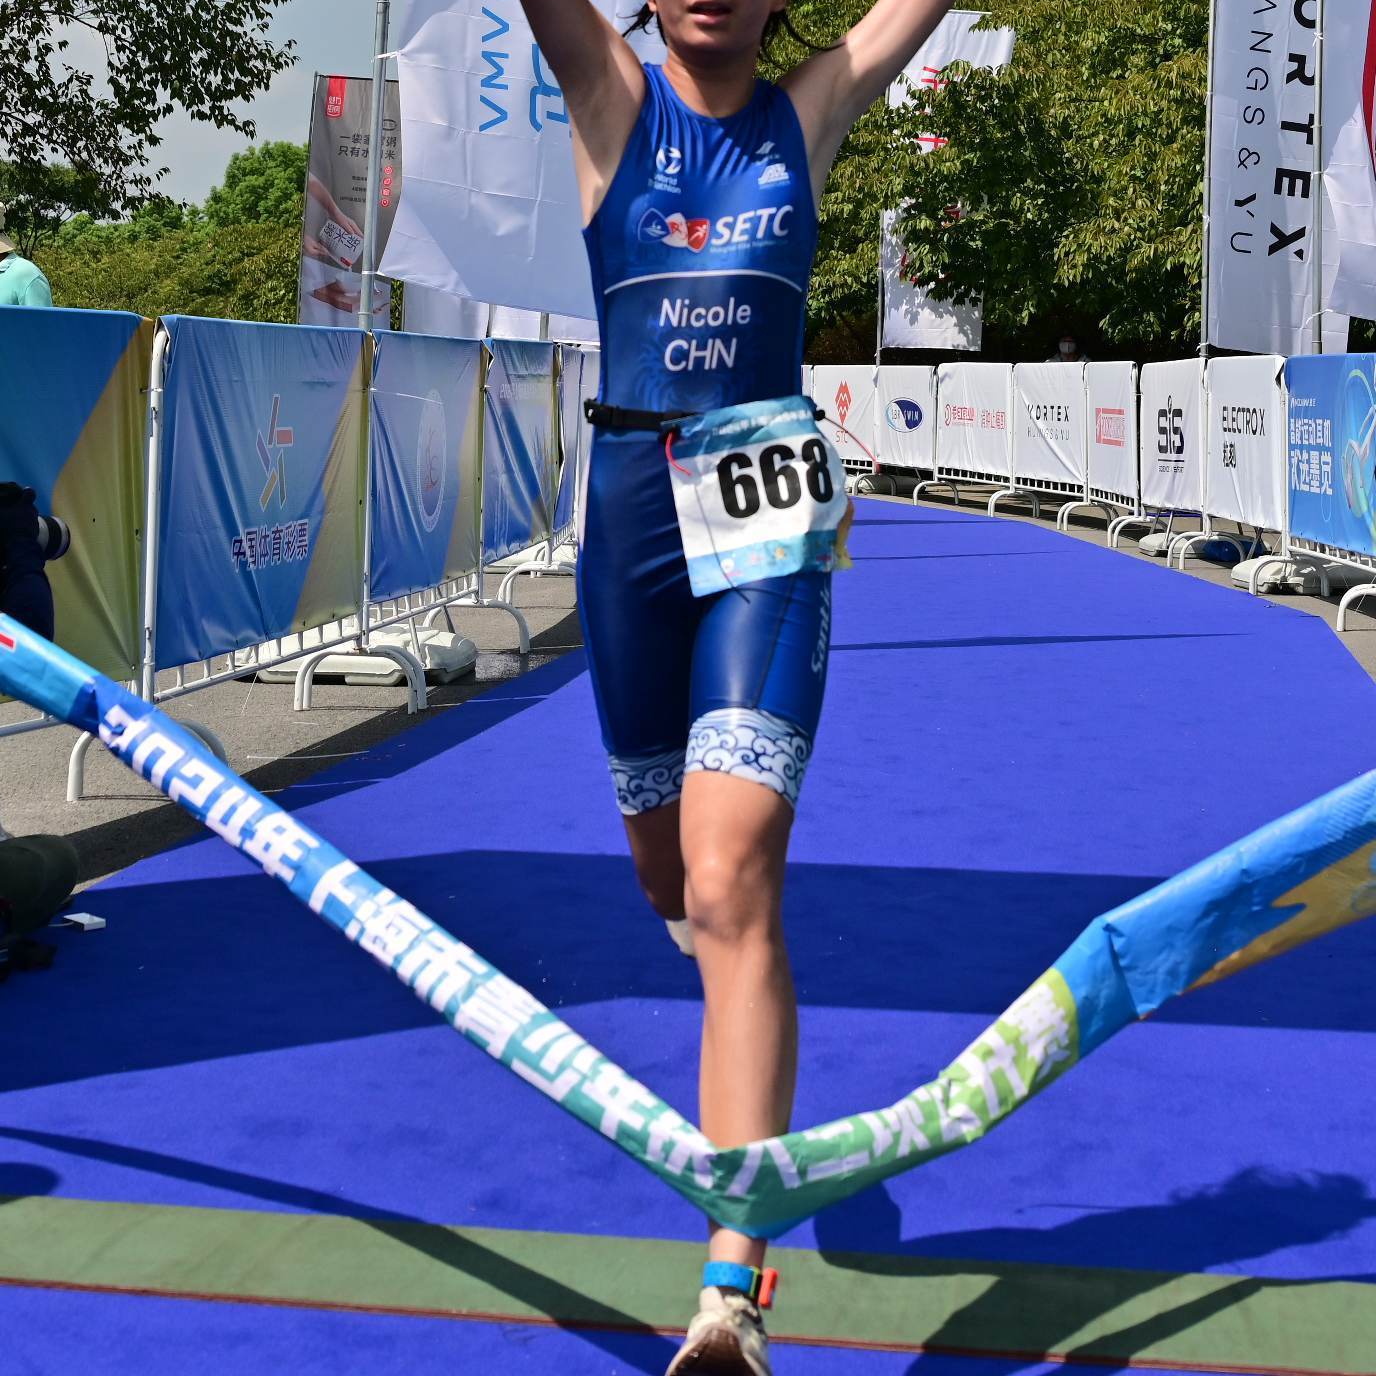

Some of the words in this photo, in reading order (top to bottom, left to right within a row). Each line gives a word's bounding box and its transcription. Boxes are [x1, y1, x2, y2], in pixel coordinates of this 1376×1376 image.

[1237, 146, 1261, 170] &
[711, 204, 794, 246] SETC
[658, 297, 752, 328] Nicole
[662, 337, 738, 374] CHN
[1222, 405, 1258, 435] ELECTRO
[717, 438, 834, 519] 668
[231, 519, 310, 572] 中国体育彩票
